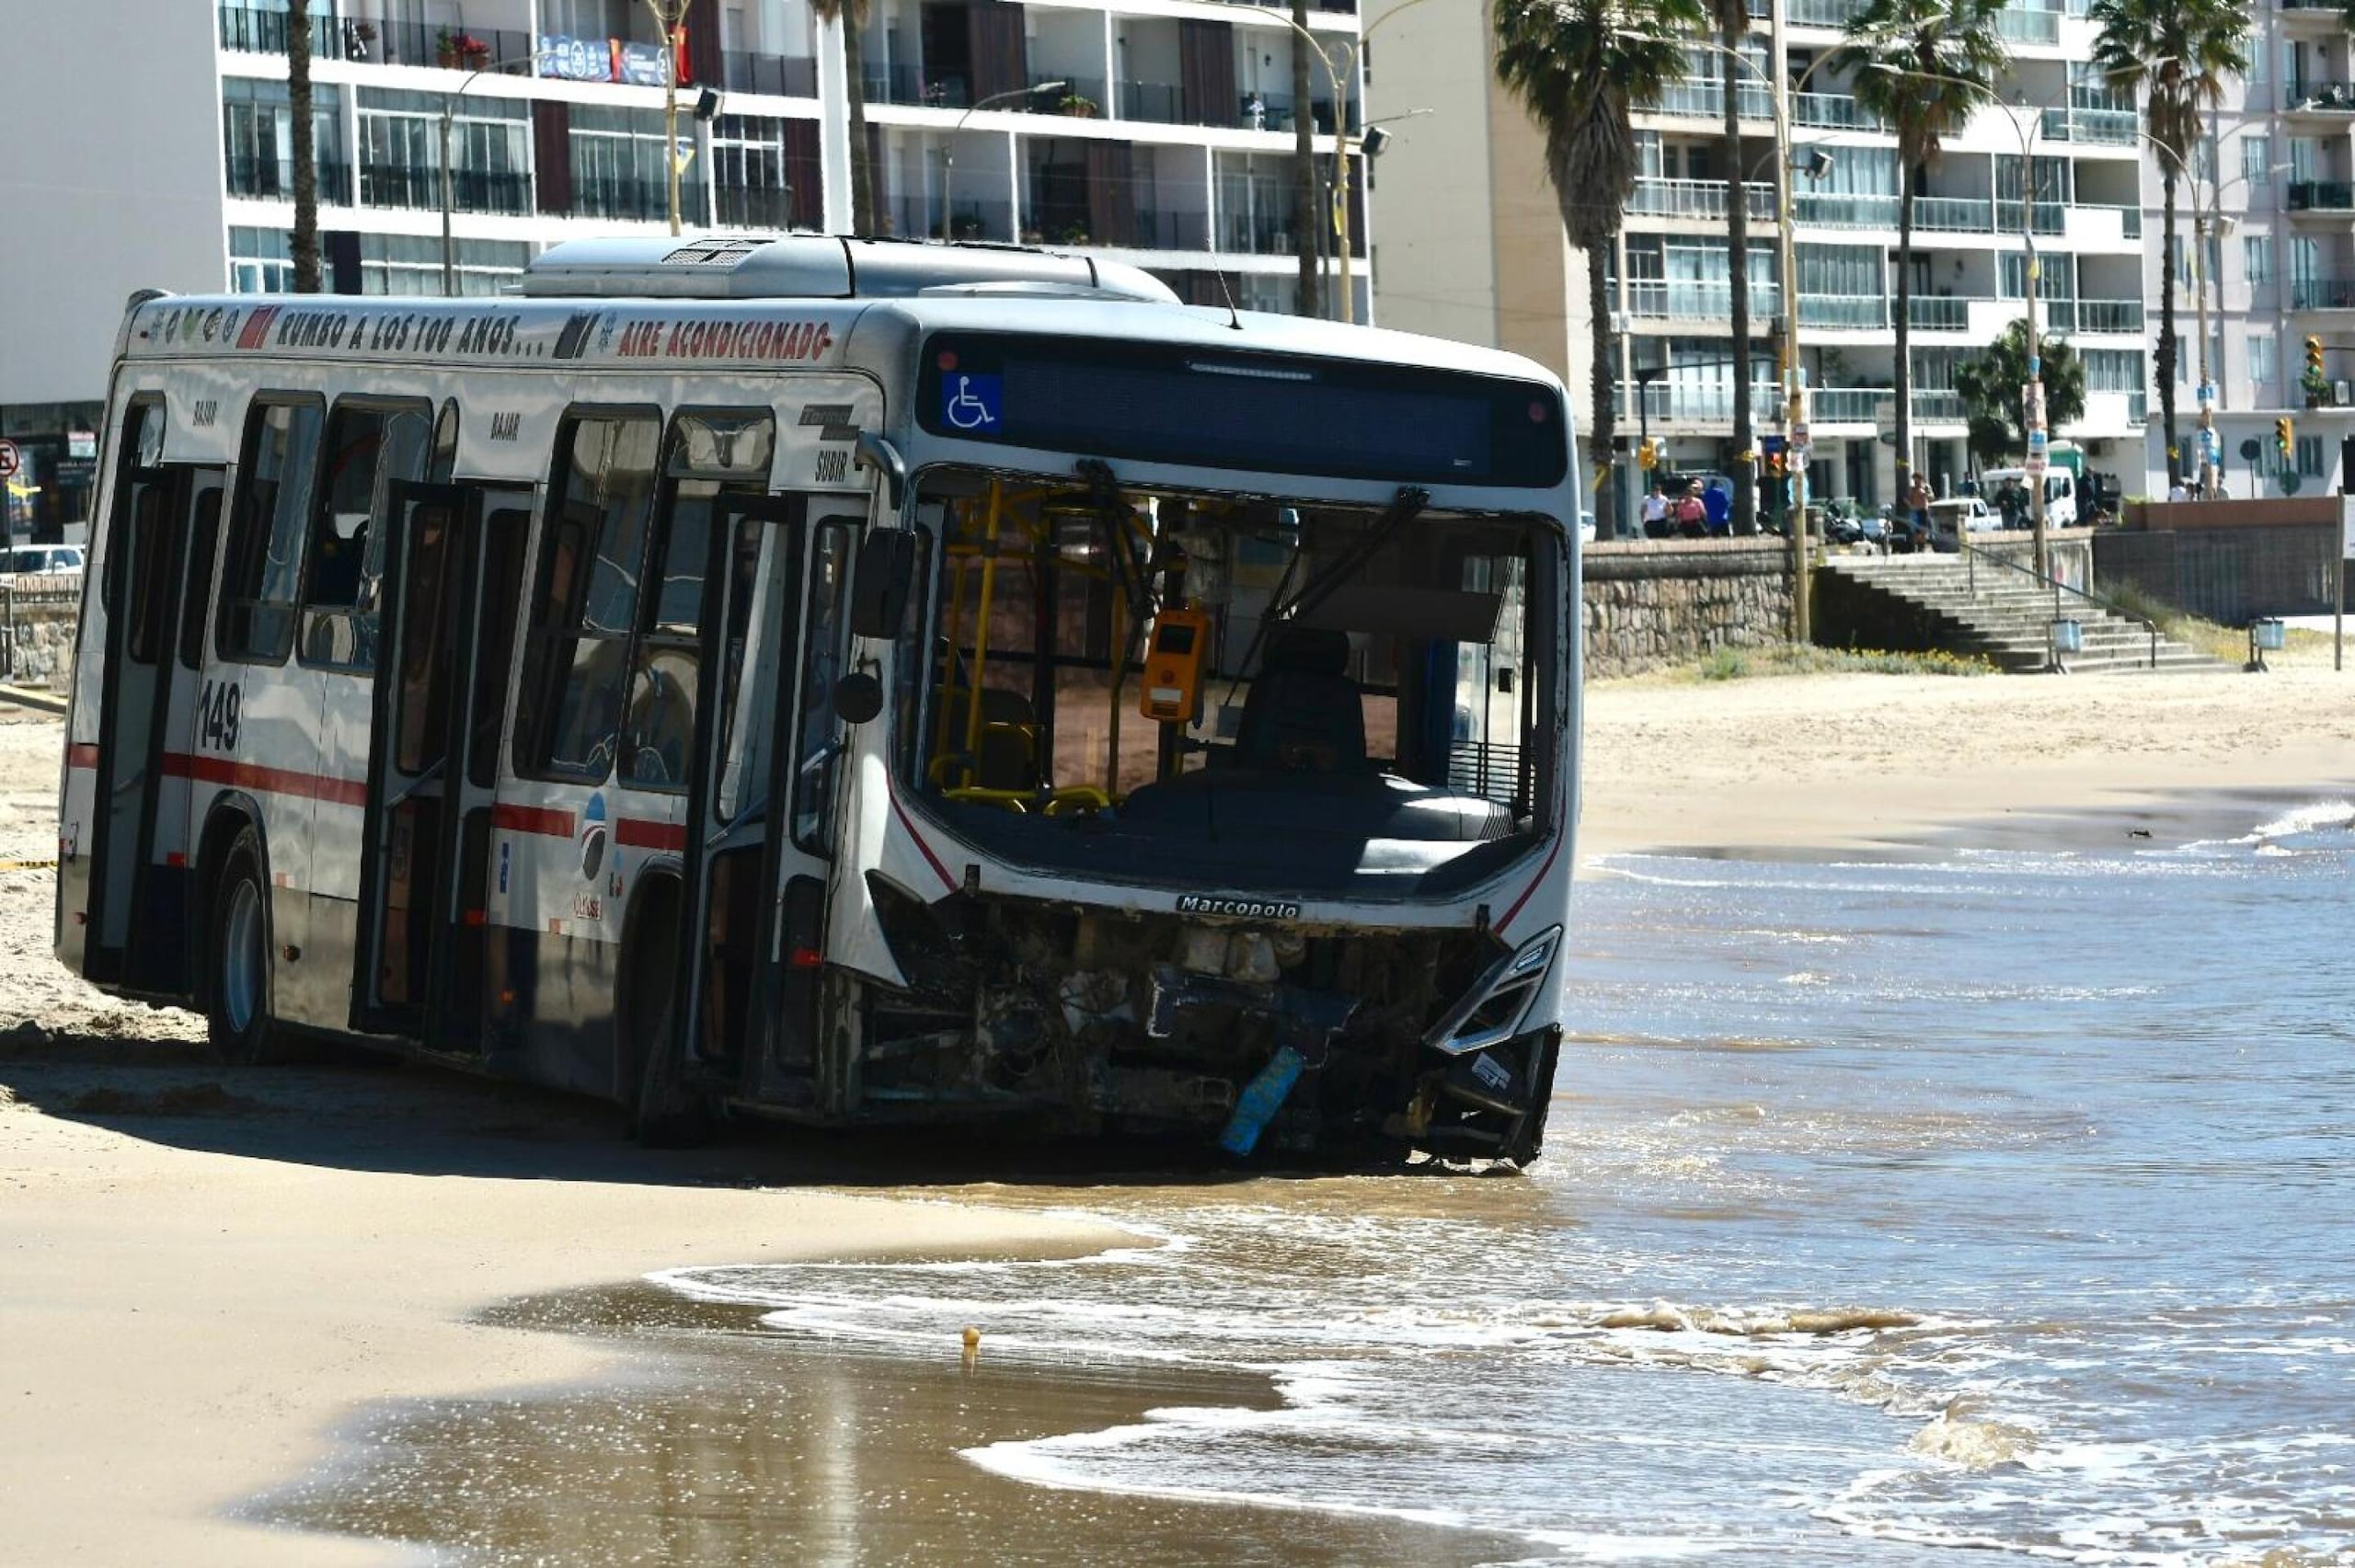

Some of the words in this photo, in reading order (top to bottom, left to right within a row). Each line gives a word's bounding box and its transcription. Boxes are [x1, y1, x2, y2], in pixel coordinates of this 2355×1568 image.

[277, 311, 348, 349] RUMBO
[349, 313, 368, 349] A
[371, 313, 415, 350] LOS
[413, 315, 456, 354] 100
[617, 321, 665, 357] AIRE
[665, 321, 830, 361] ACONDICIONADO
[489, 411, 522, 441] BAJAR
[814, 449, 848, 483] SUBIR
[200, 679, 241, 751] 149
[1180, 896, 1297, 918] Marcopolo
